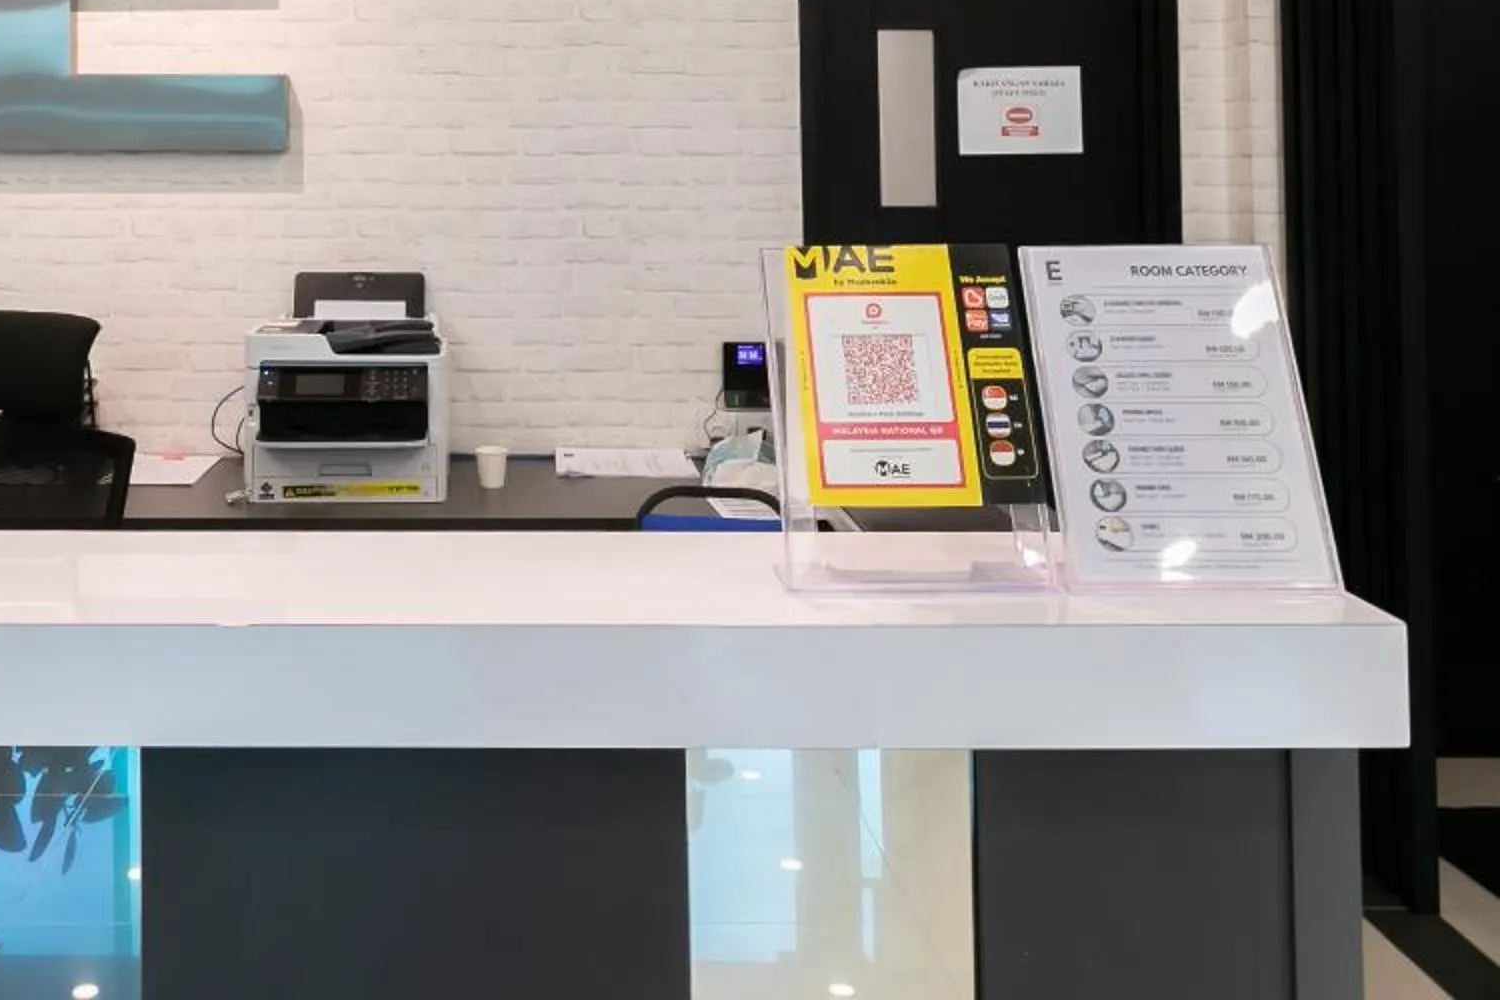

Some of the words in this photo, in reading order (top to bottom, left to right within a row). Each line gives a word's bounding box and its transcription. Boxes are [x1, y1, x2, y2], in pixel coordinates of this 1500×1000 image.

[1045, 260, 1063, 281] E
[1130, 265, 1173, 277] ROOM
[1175, 264, 1248, 277] CATEGORY
